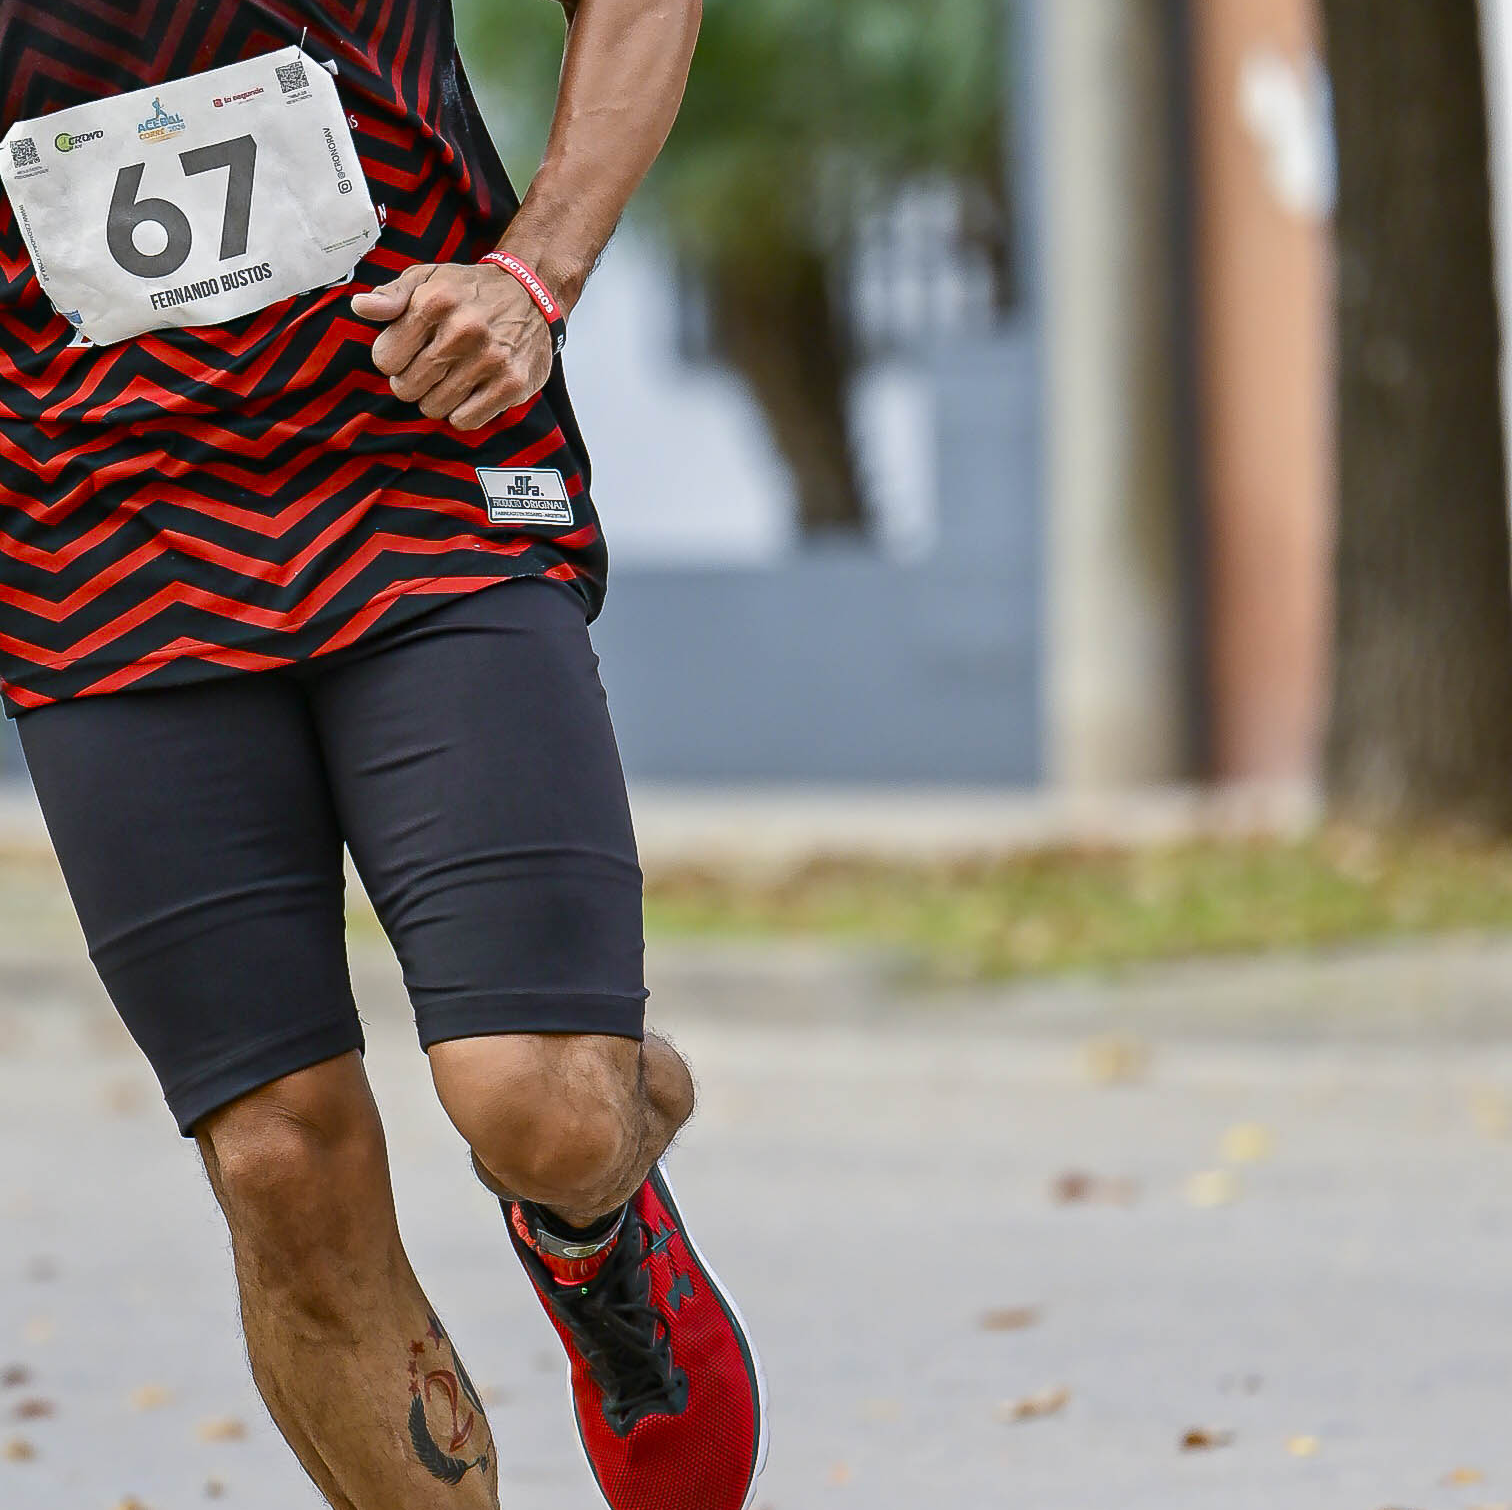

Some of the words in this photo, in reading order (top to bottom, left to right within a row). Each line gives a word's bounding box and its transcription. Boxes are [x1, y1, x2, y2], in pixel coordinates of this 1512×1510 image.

[322, 127, 346, 180] @CRONORAV
[106, 133, 258, 279] 67
[150, 278, 219, 311] FERNANDO
[220, 262, 273, 293] BUSTOS
[522, 499, 566, 511] ORIGINAL
